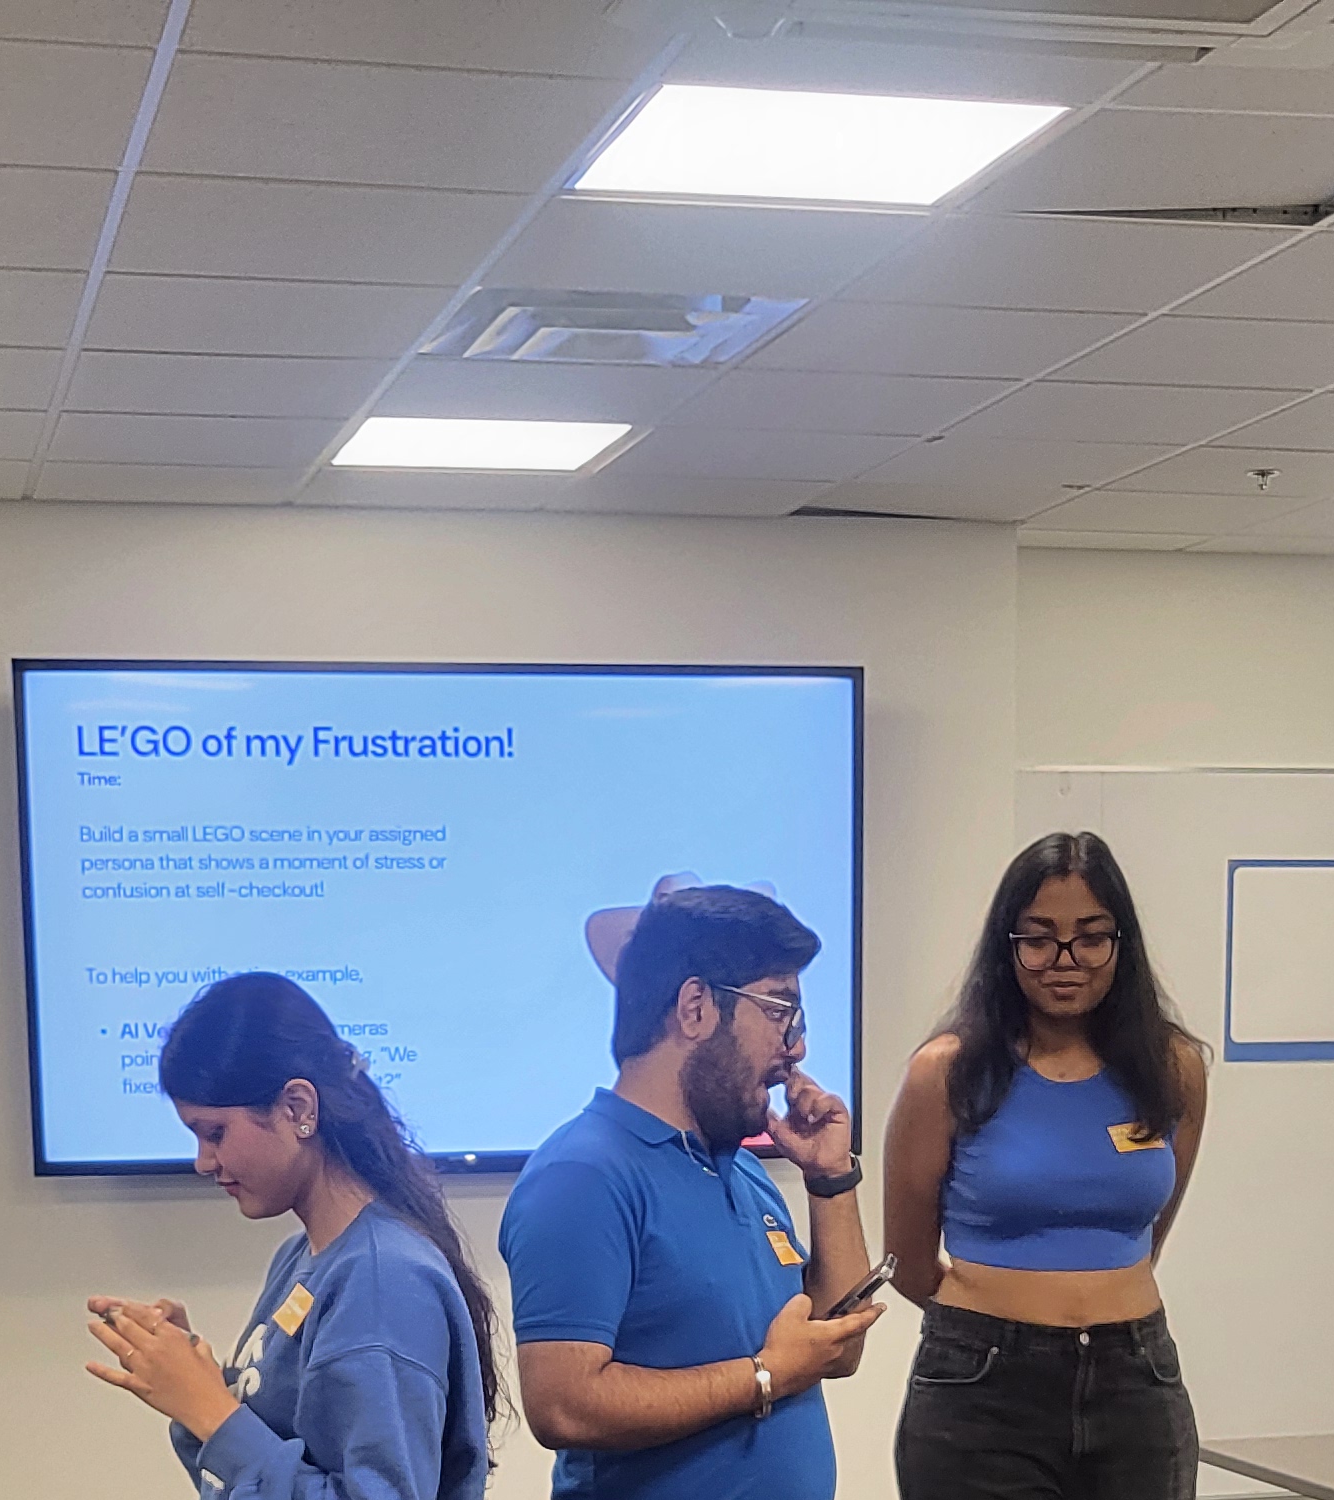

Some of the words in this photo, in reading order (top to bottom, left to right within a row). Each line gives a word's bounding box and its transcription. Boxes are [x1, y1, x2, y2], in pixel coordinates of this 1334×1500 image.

[201, 725, 238, 758] of
[245, 734, 304, 766] my
[312, 726, 515, 758] Frustration!
[76, 771, 122, 787] Time:
[79, 825, 124, 843] Build
[128, 829, 140, 843] a
[142, 825, 189, 843] small
[192, 825, 246, 843] LEGO
[249, 829, 303, 843] scene
[306, 825, 322, 842] in
[325, 829, 365, 846] your
[368, 824, 447, 846] assigned
[80, 857, 155, 876] persona
[157, 853, 194, 871] that
[198, 853, 255, 871] shows
[259, 857, 270, 870] a
[273, 854, 349, 870] moment
[352, 851, 370, 870] of
[374, 854, 426, 870] stress
[428, 856, 447, 870] or
[81, 881, 171, 900] confusion
[174, 884, 192, 899] at
[196, 879, 325, 899] self-checkout!
[85, 967, 108, 985] To
[111, 966, 151, 987] help
[156, 970, 188, 987] you
[285, 965, 364, 986] example,
[120, 1022, 139, 1040] AI
